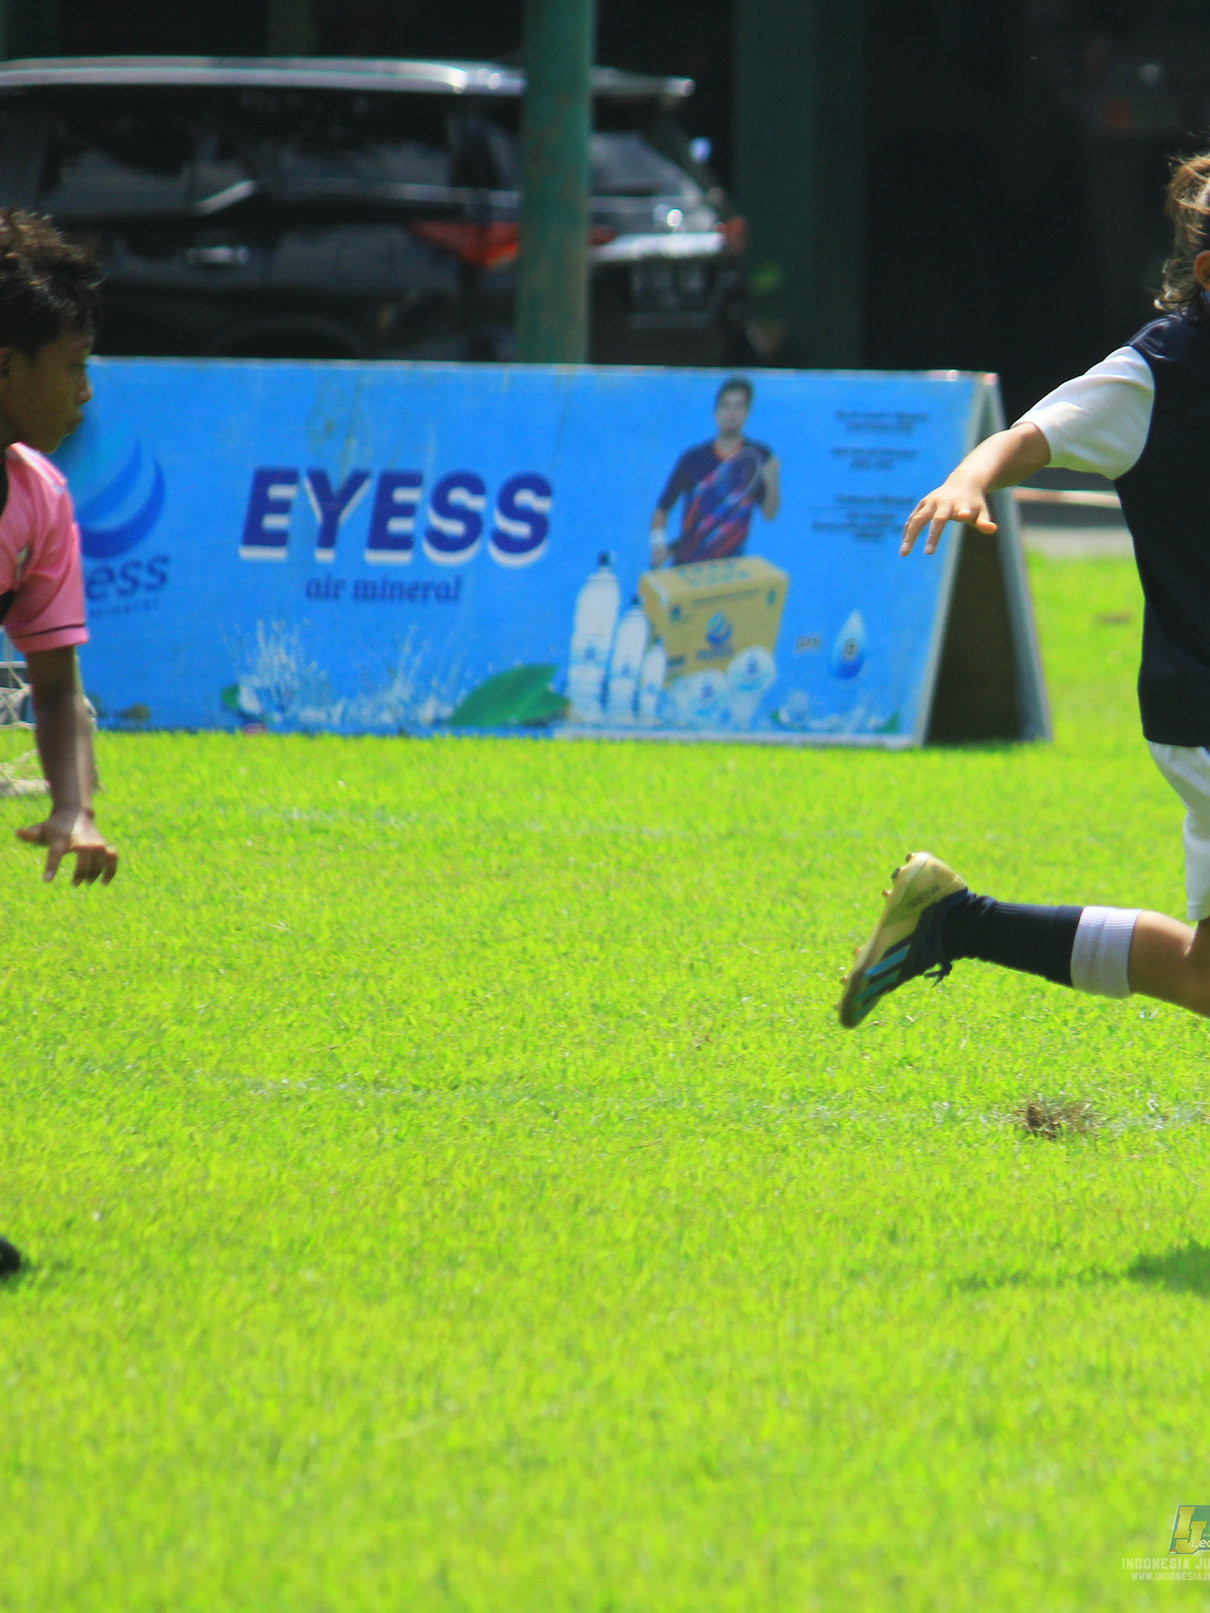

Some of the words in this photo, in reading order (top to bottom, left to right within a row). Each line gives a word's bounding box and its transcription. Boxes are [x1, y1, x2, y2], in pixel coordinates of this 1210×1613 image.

[239, 466, 554, 568] EYESS
[85, 554, 171, 601] ess
[305, 572, 346, 600] air
[353, 573, 463, 602] mineral
